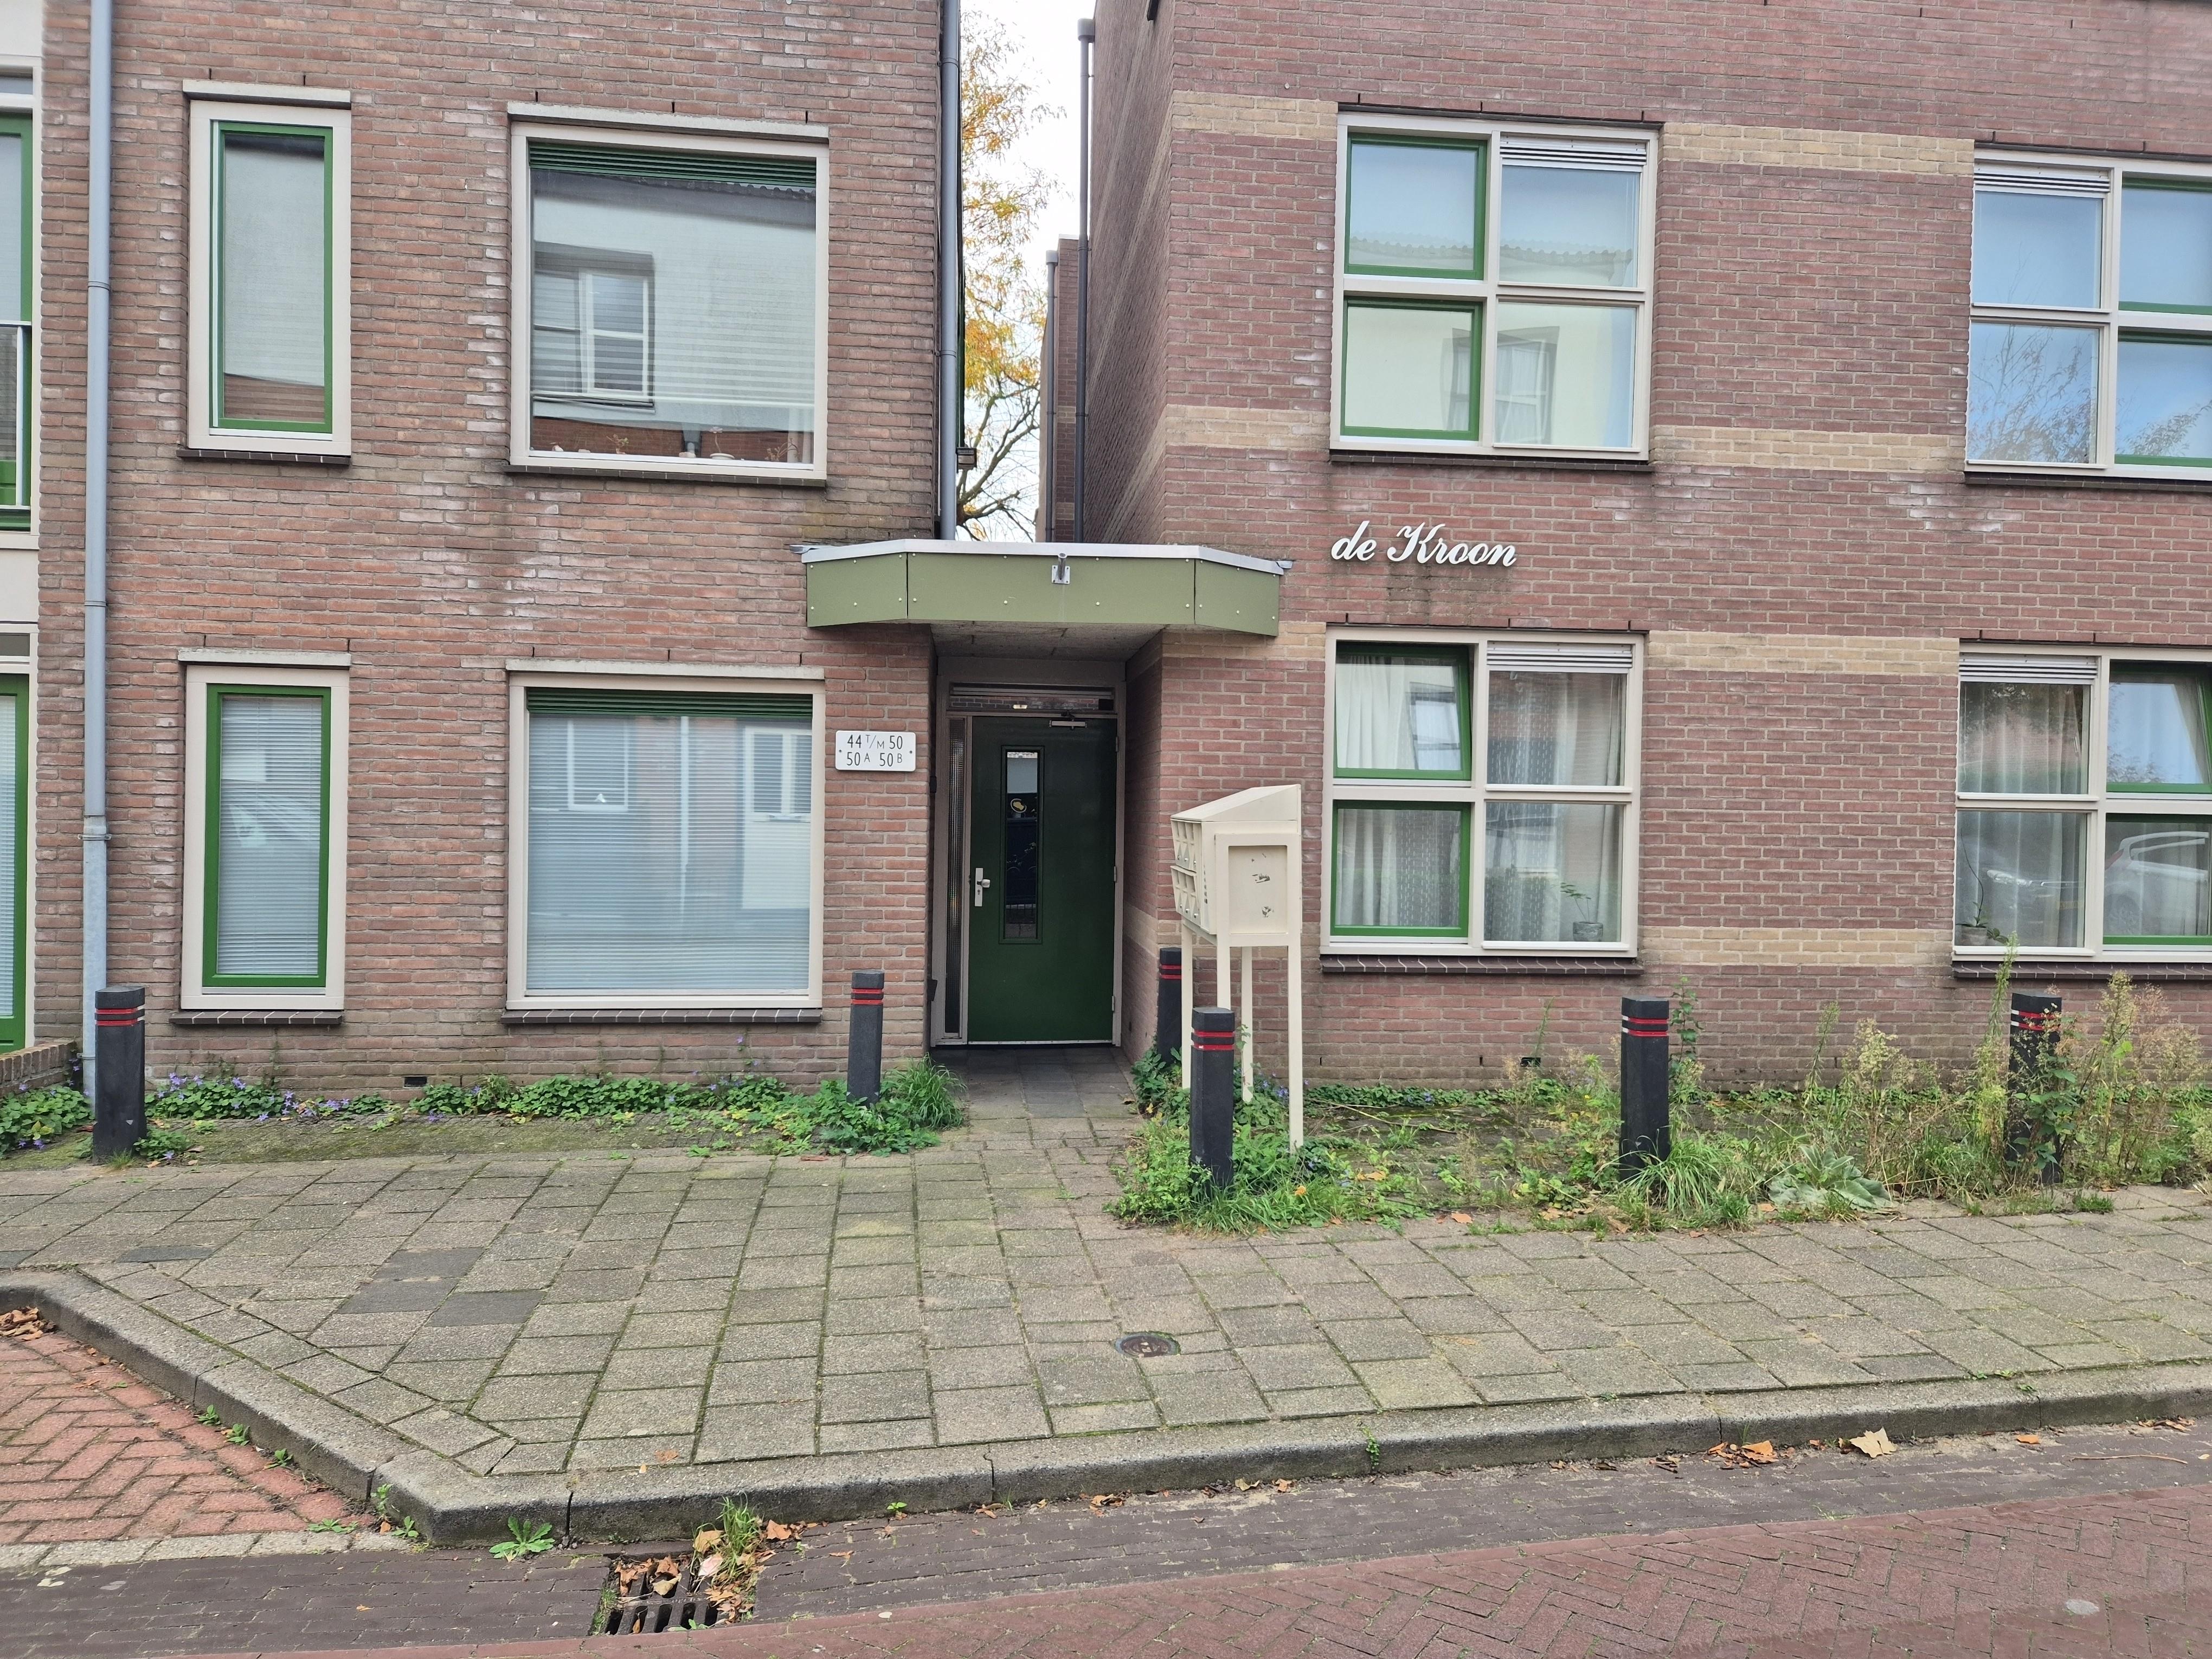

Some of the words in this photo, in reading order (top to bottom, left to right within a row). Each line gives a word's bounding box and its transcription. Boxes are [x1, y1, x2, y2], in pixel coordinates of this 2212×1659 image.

[1331, 520, 1377, 561] de
[1386, 522, 1516, 567] Kroon
[847, 734, 861, 749] 44
[889, 735, 903, 749] 50
